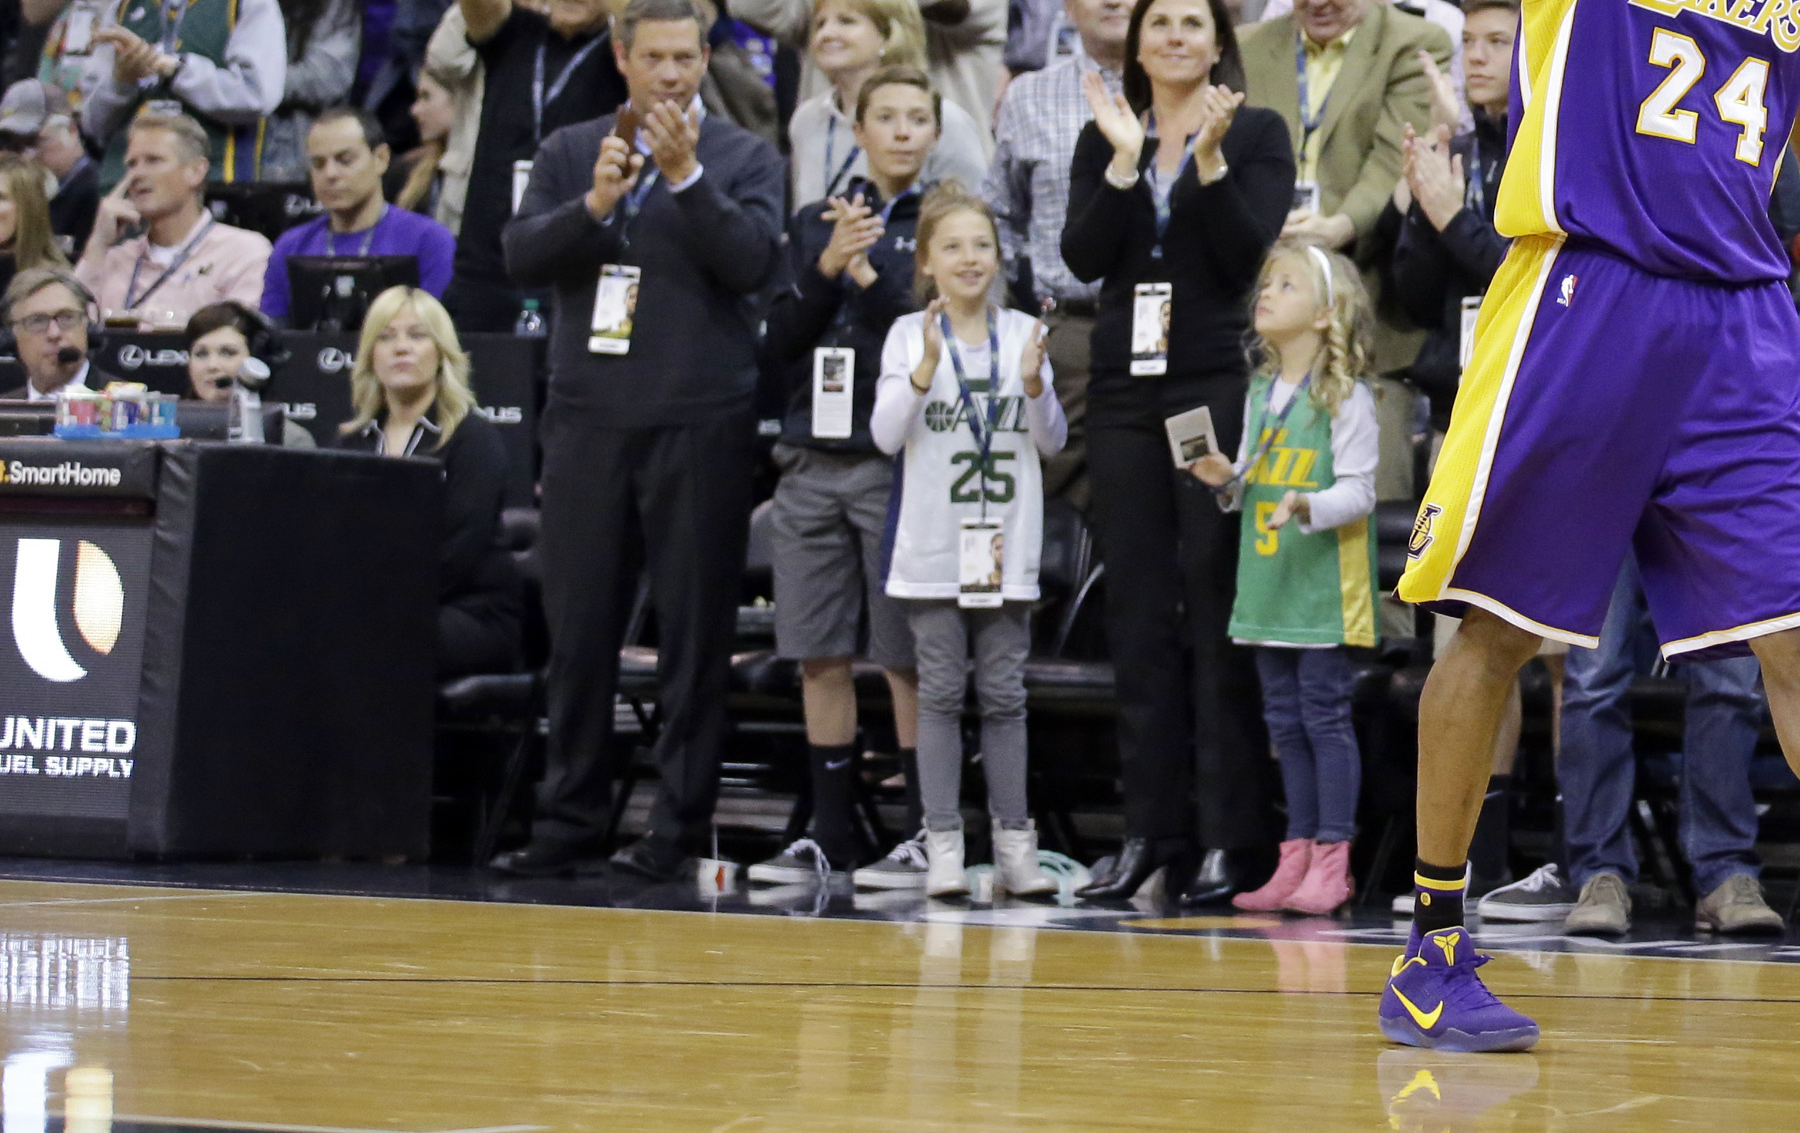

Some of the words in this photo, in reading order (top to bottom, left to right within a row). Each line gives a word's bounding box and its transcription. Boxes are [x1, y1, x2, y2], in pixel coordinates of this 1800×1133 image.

[1635, 27, 1770, 167] 24
[950, 450, 1016, 504] 25
[1255, 501, 1281, 556] 5
[44, 756, 134, 778] SUPPLY
